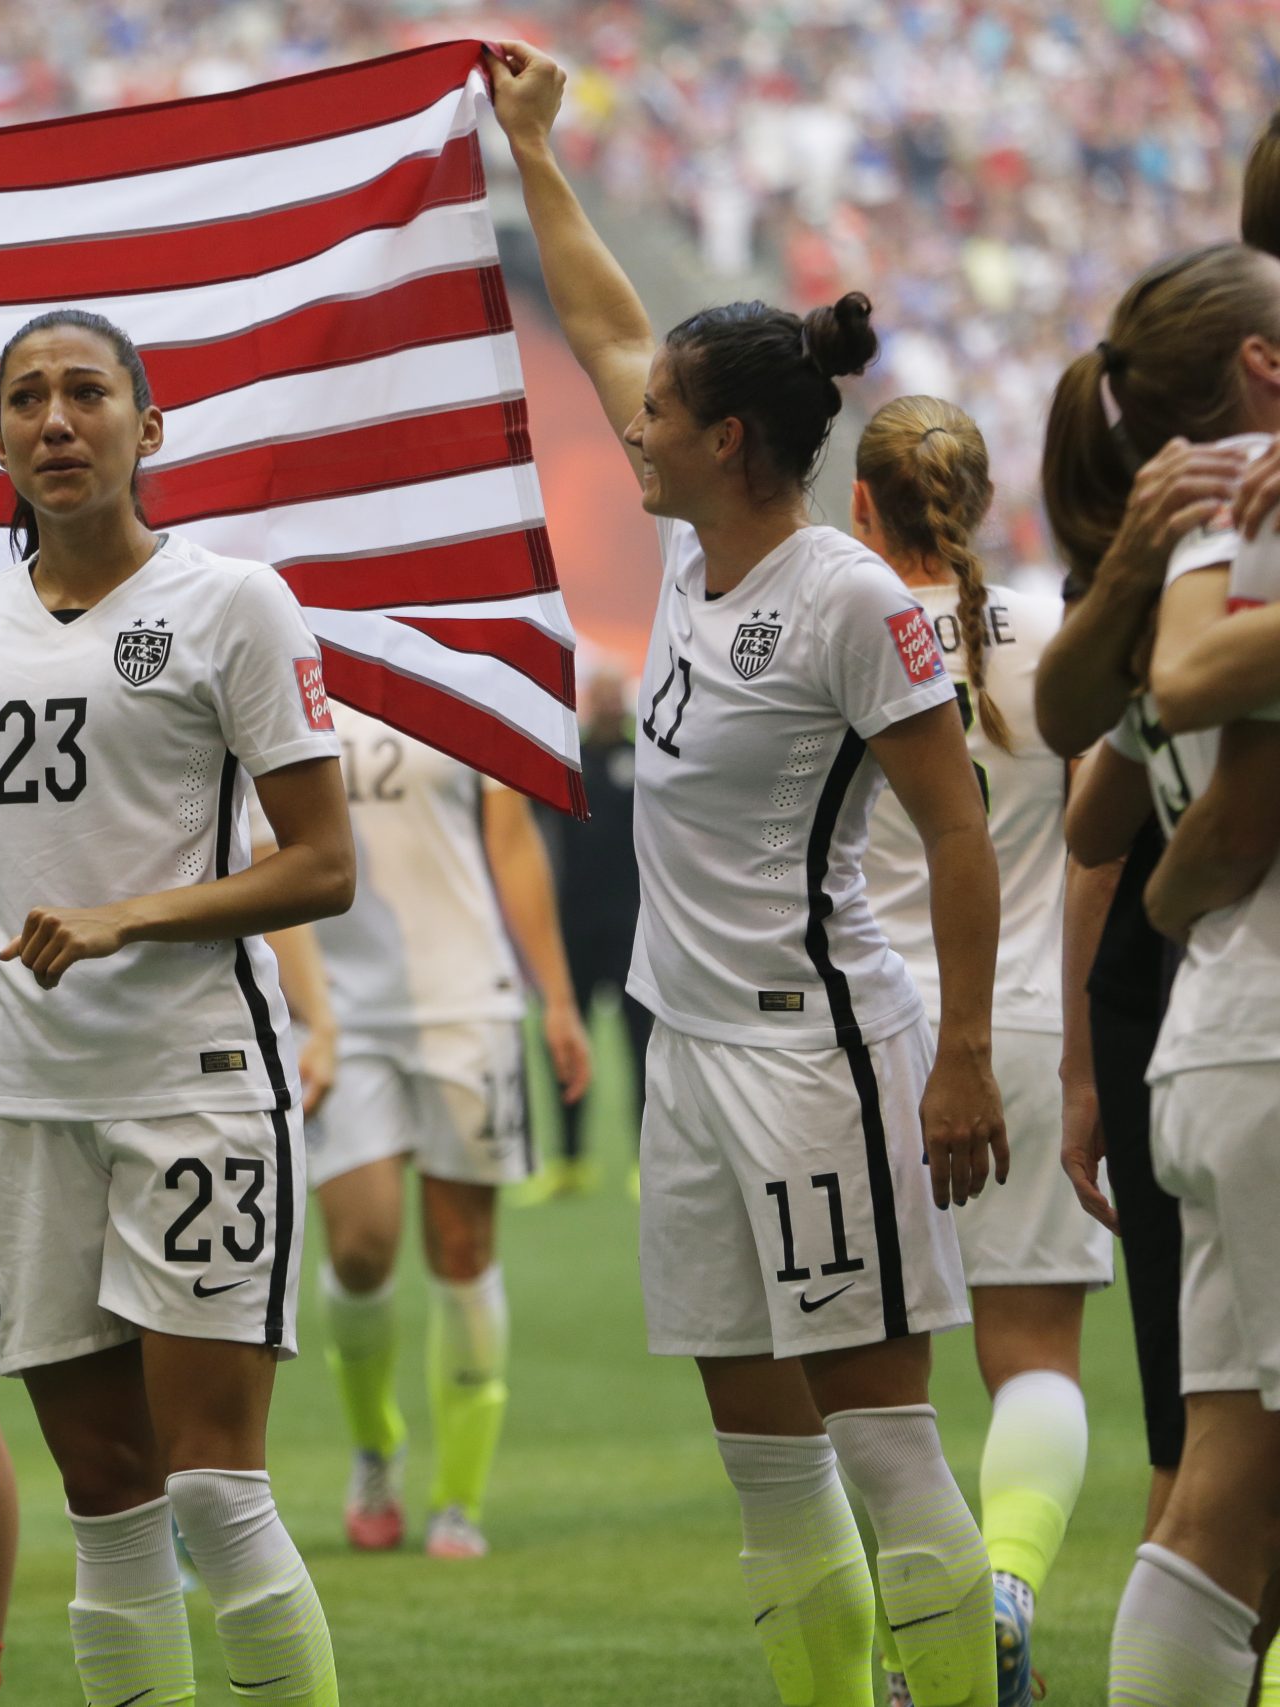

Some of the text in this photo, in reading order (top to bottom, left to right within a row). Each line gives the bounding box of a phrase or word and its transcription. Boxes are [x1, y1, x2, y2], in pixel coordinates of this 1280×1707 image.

[306, 681, 325, 705] YOU
[643, 646, 692, 758] 11
[342, 737, 404, 802] 12
[164, 1157, 266, 1263] 23
[765, 1172, 865, 1282] 11
